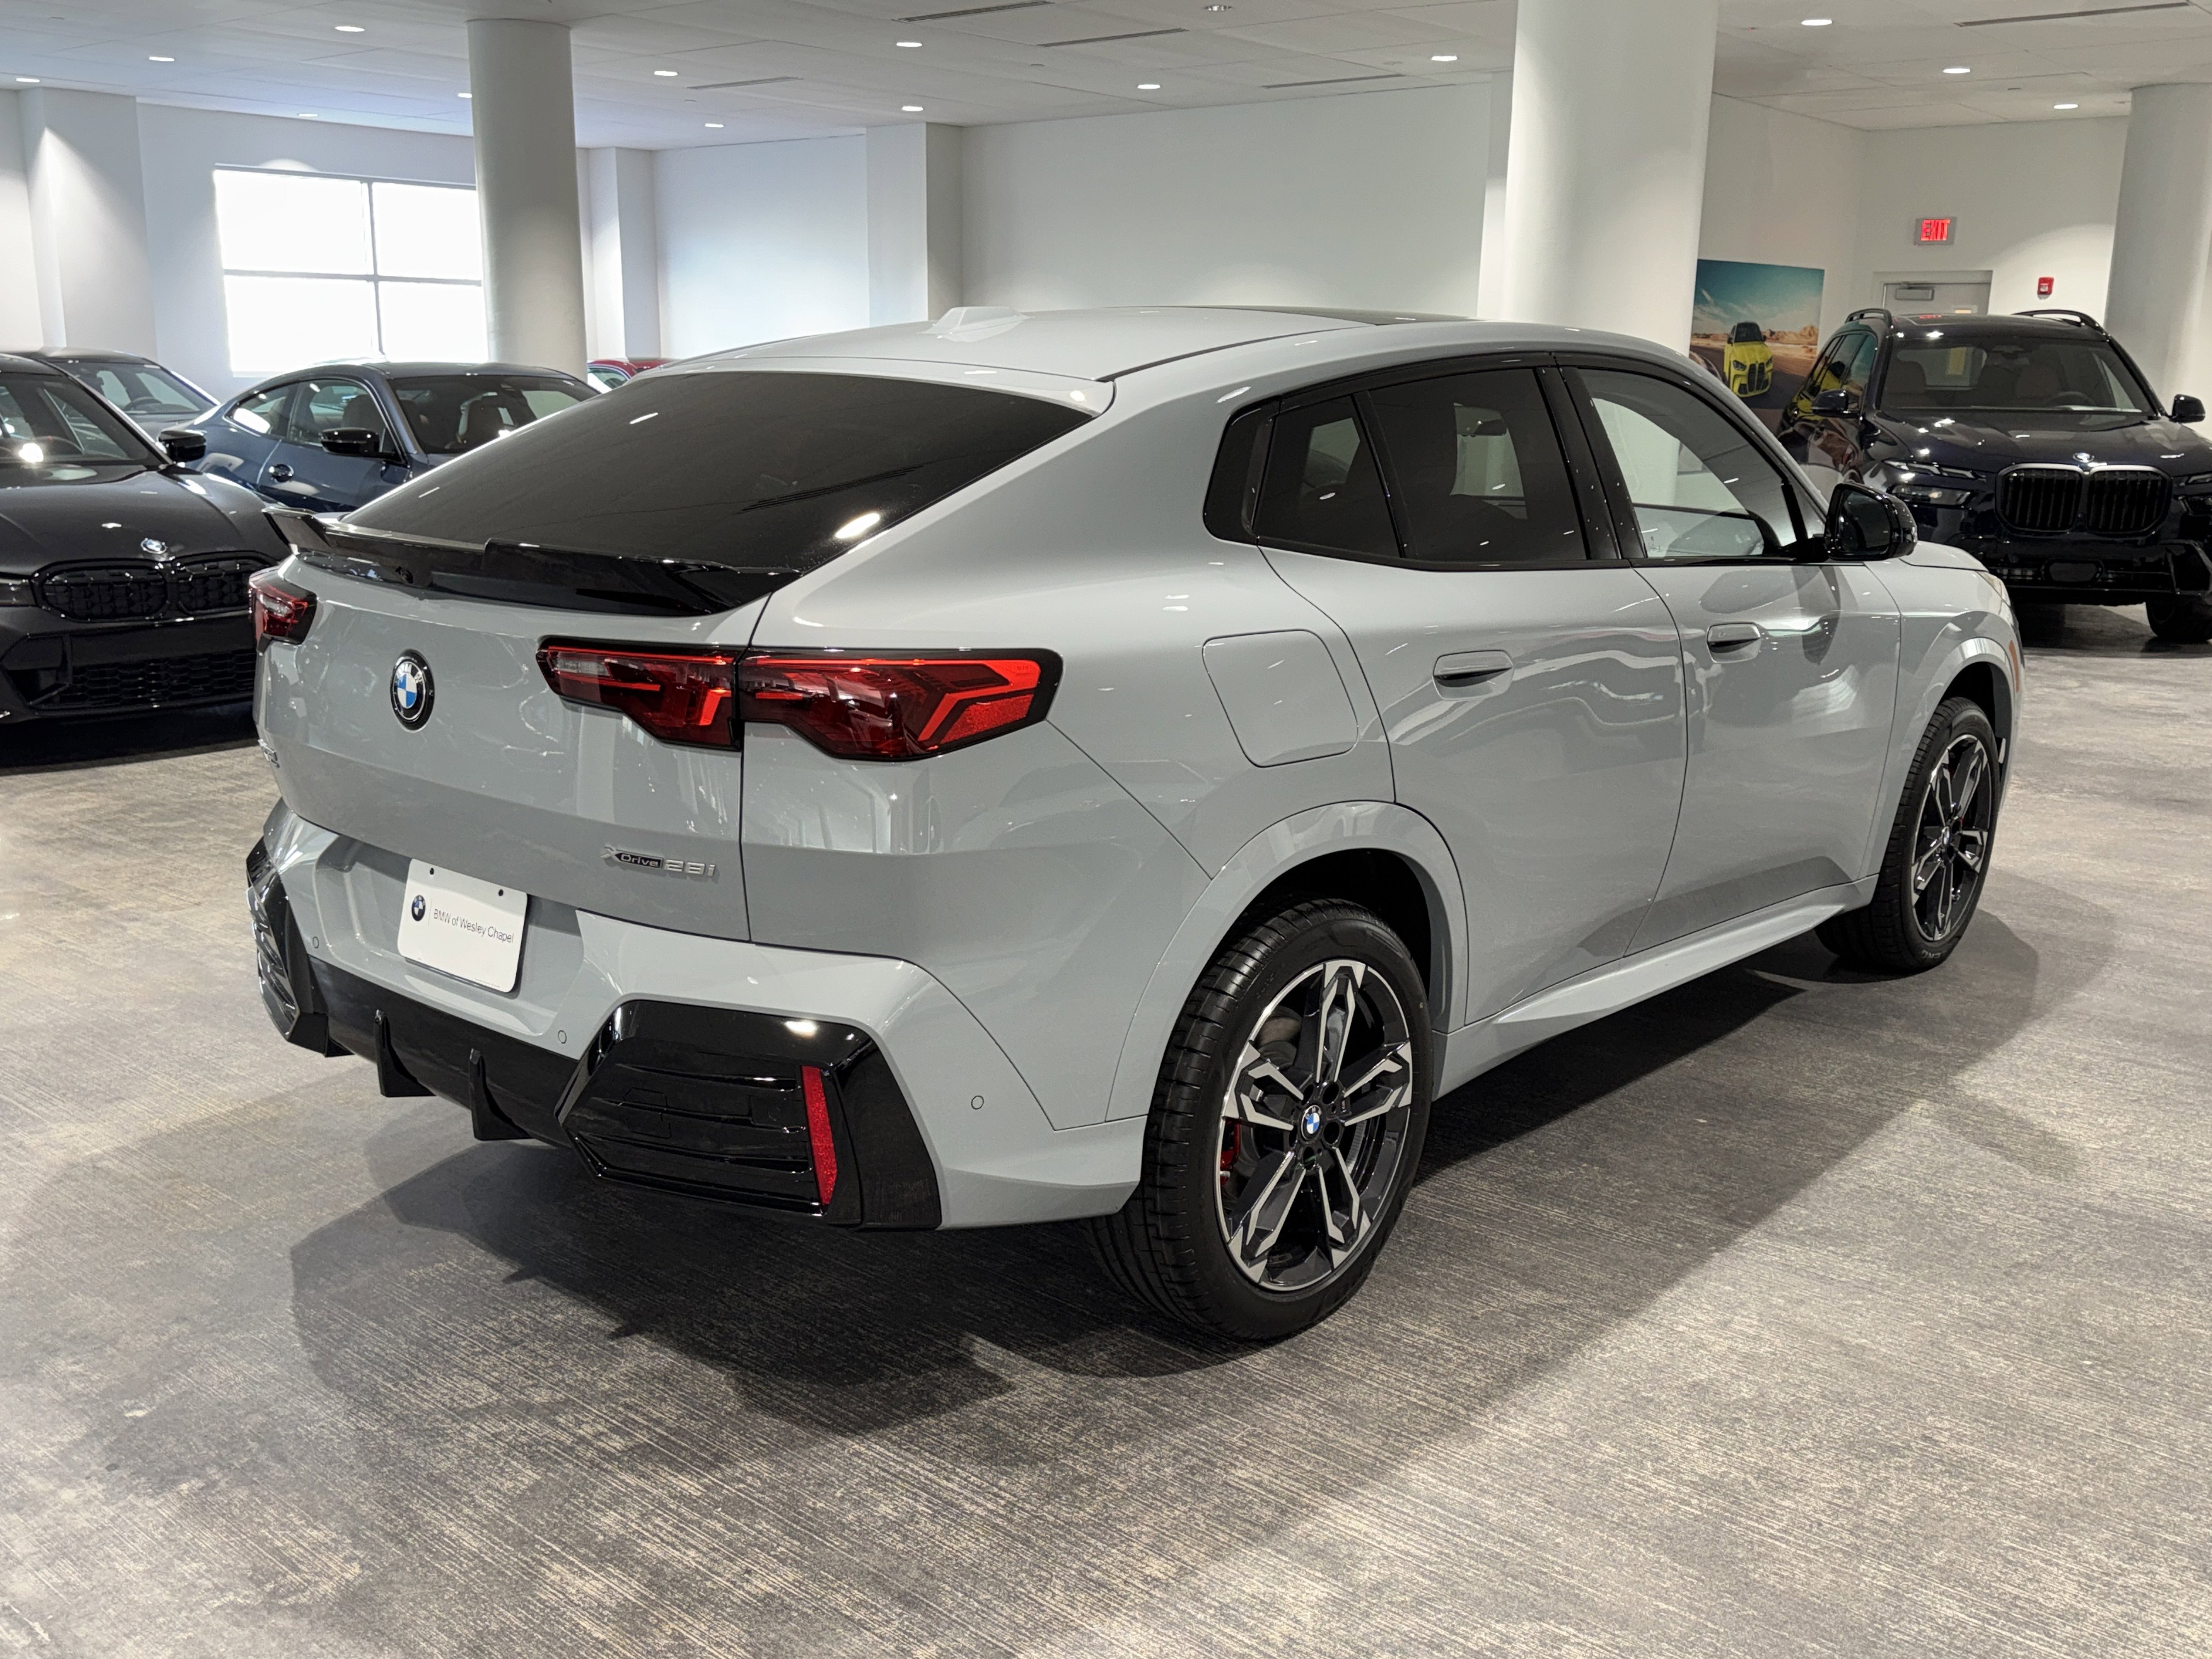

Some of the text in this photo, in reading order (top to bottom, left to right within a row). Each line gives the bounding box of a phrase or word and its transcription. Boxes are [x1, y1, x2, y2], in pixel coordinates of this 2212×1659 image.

[1921, 219, 1950, 240] EXIT
[434, 909, 515, 943] BMW of Wesley Chapel
